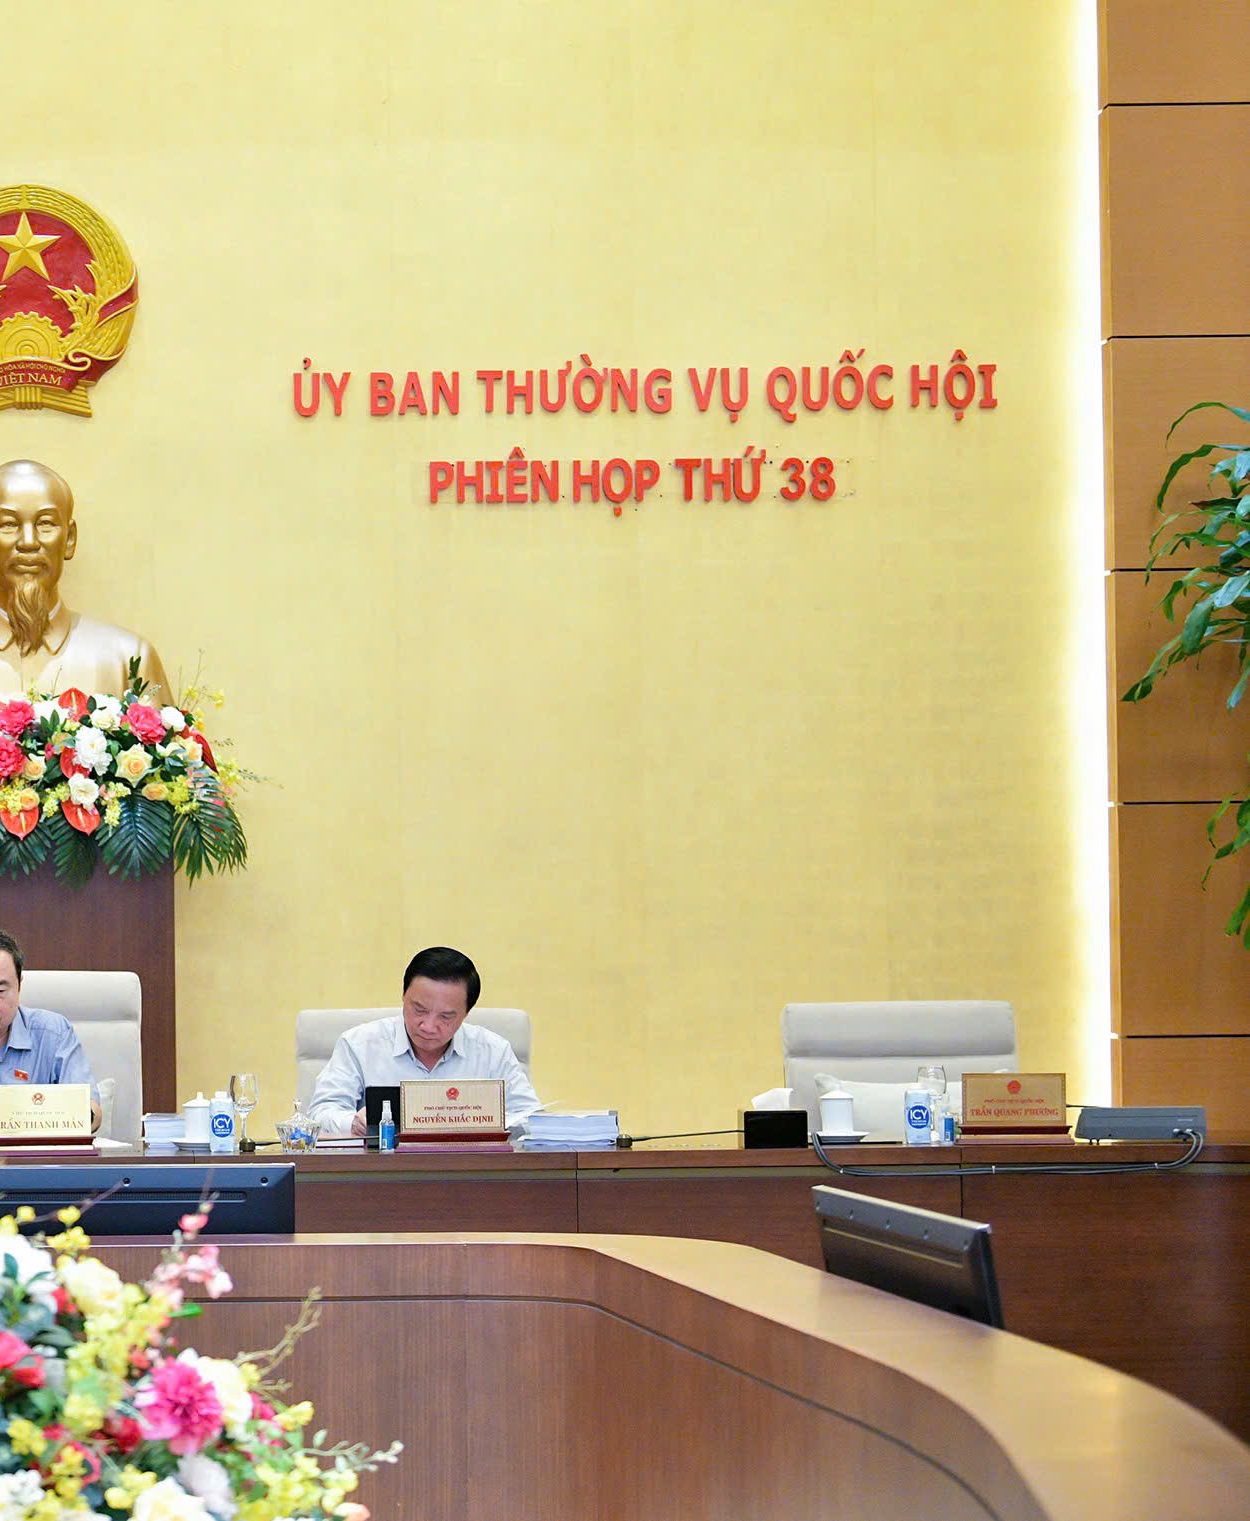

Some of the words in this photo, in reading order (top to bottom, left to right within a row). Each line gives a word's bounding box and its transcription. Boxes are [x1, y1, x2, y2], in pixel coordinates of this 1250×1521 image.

[27, 372, 63, 386] NAM
[292, 356, 352, 417] ỦY
[369, 371, 460, 417] BAN
[476, 353, 674, 413] THƯỜNG
[687, 367, 749, 423] VỤ
[765, 348, 895, 423] QUỐC
[909, 349, 998, 421] HỘI
[428, 445, 560, 504] PHIÊN
[573, 457, 660, 517] HỌP
[675, 445, 767, 503] THỨ
[779, 455, 836, 503] 38
[910, 1109, 927, 1120] ICY
[994, 1108, 1022, 1117] QUANG
[213, 1118, 230, 1129] ICY
[448, 1113, 472, 1123] KHẮC
[473, 1115, 494, 1124] ĐỊNH
[24, 1120, 59, 1129] THANH
